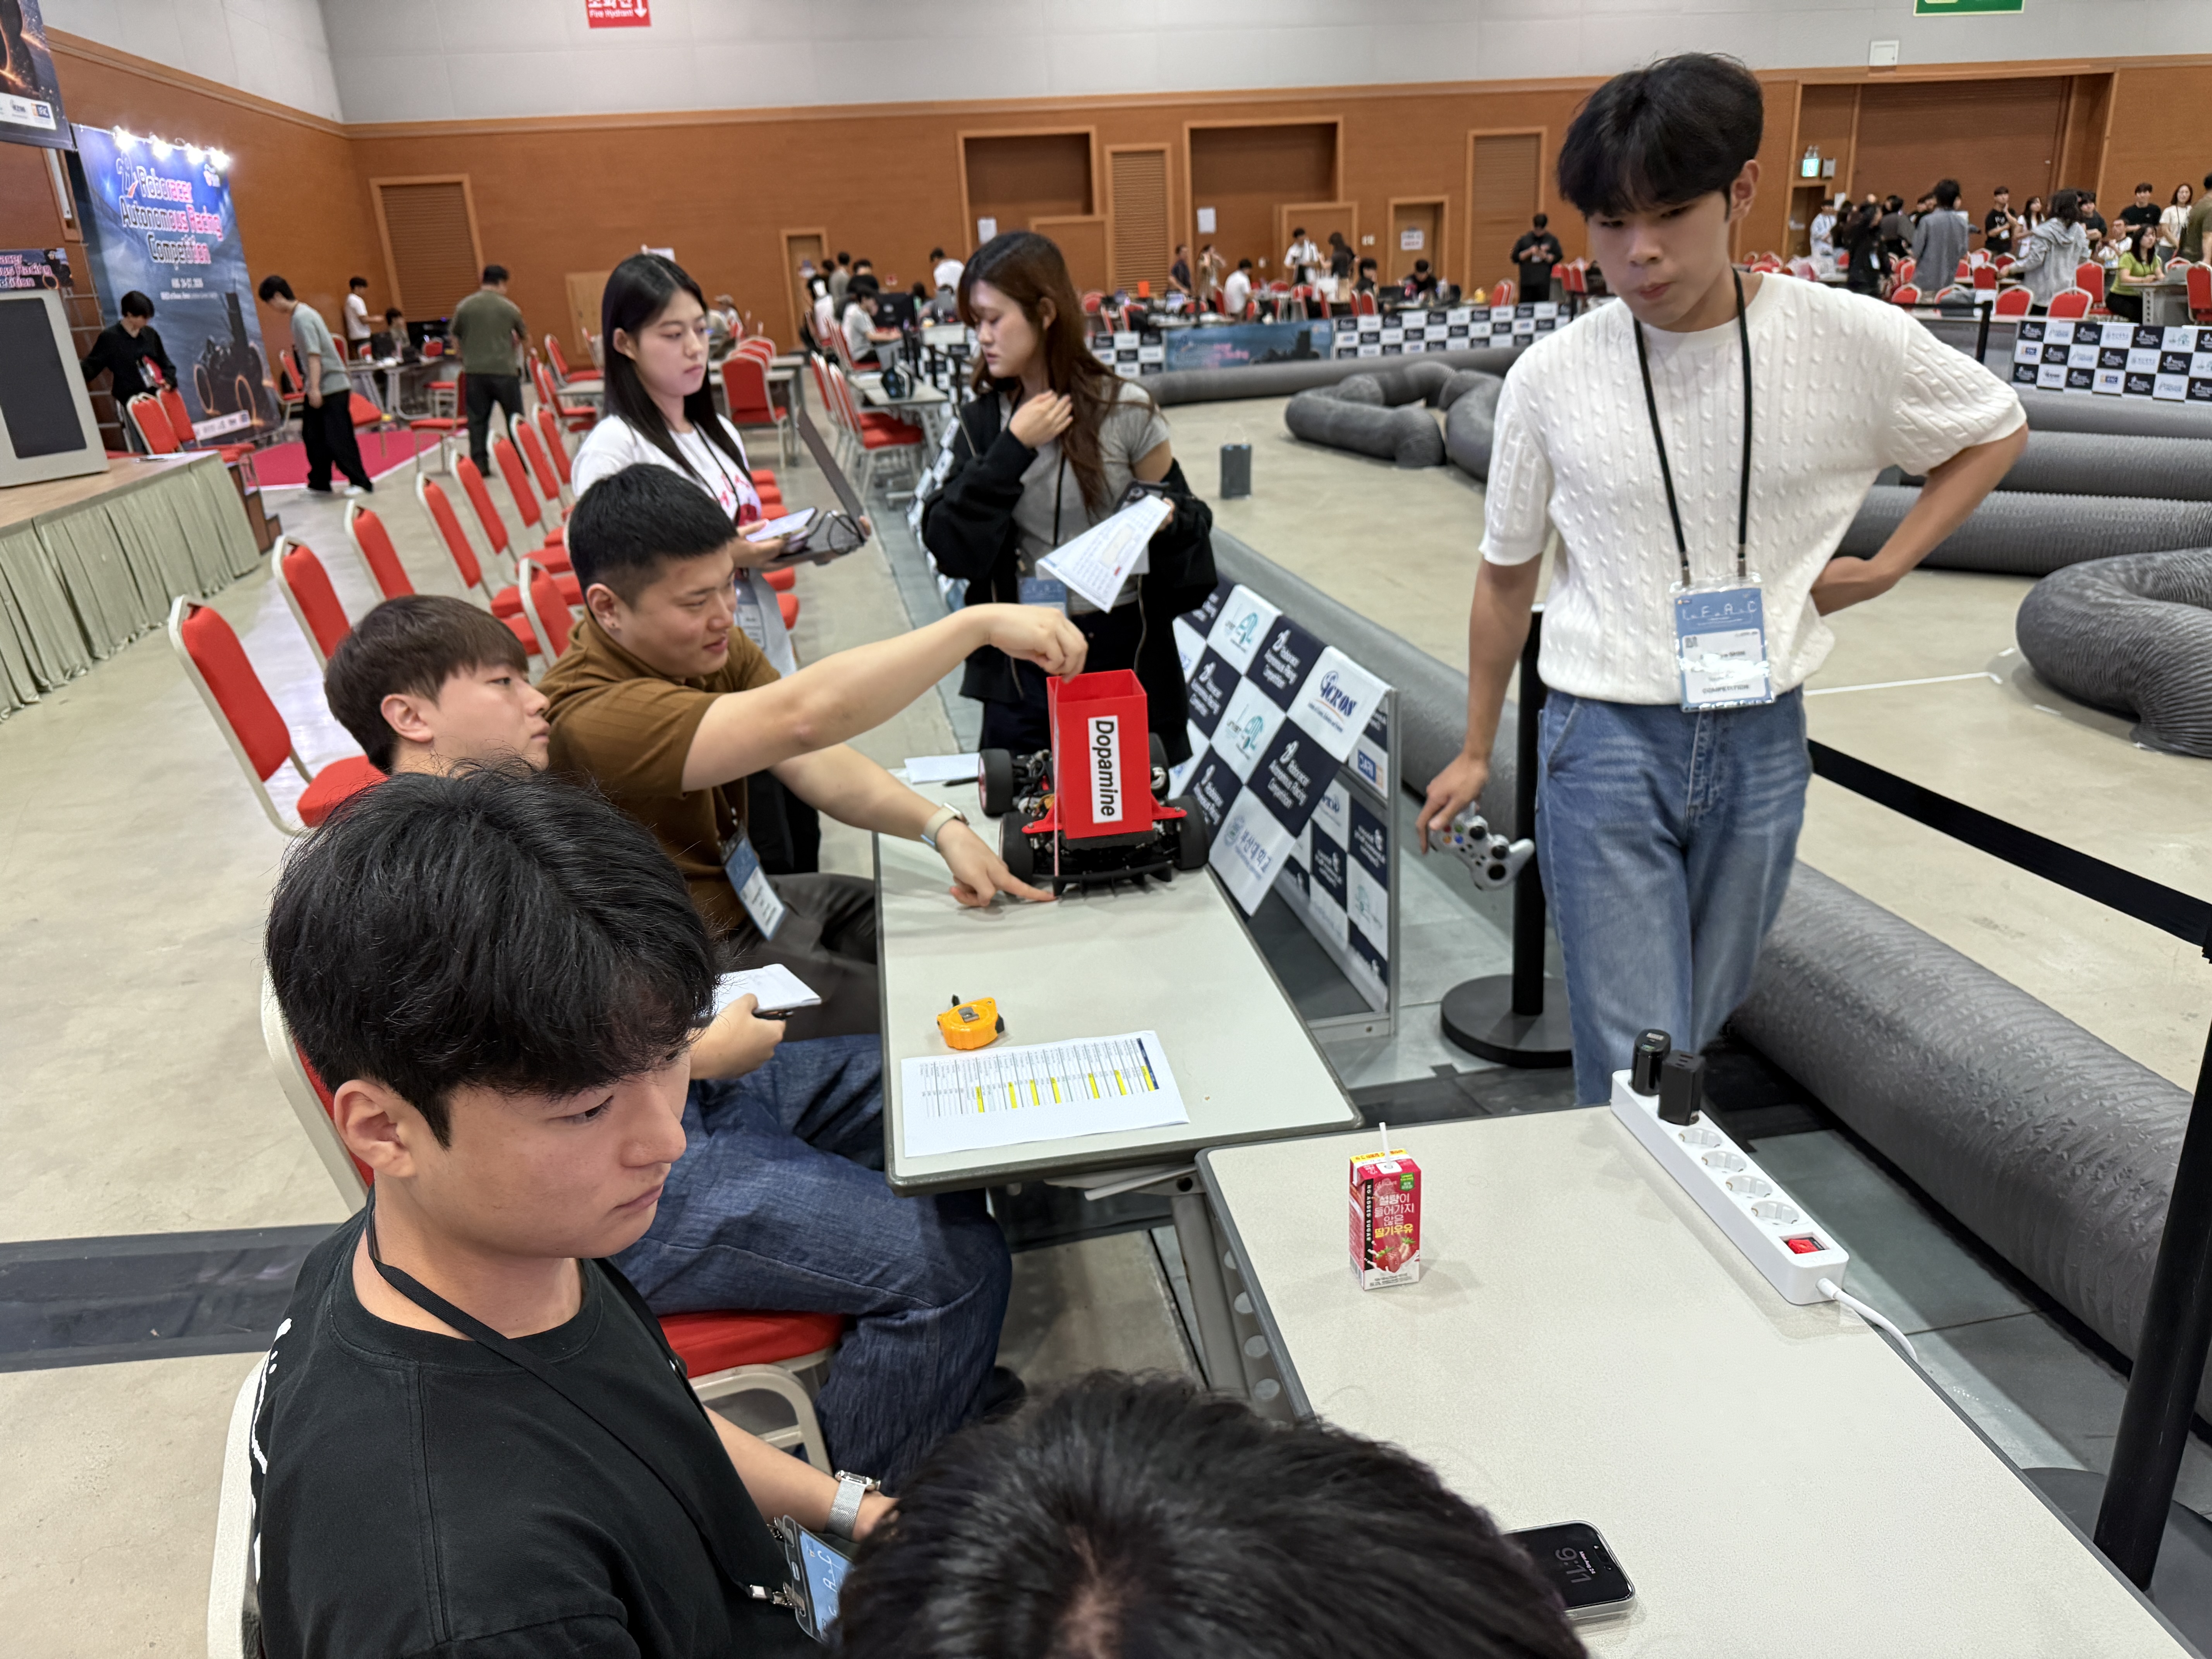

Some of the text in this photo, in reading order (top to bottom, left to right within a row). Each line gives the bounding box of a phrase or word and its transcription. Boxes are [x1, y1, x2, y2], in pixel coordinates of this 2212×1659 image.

[589, 9, 604, 18] Fire
[137, 166, 193, 203] Roboracer
[119, 195, 223, 241] Autonomous Racing
[147, 231, 211, 270] Competition
[1320, 682, 1357, 718] ICROS
[1092, 720, 1118, 816] Dopamine
[1240, 829, 1272, 873] 부산대학교
[1367, 1185, 1372, 1194] NO
[1379, 1193, 1409, 1206] 설탕이
[1374, 1203, 1414, 1218] 들어가지
[1384, 1214, 1404, 1227] 않은
[1375, 1223, 1413, 1238] 딸기우유
[1555, 1547, 1592, 1583] 9:11
